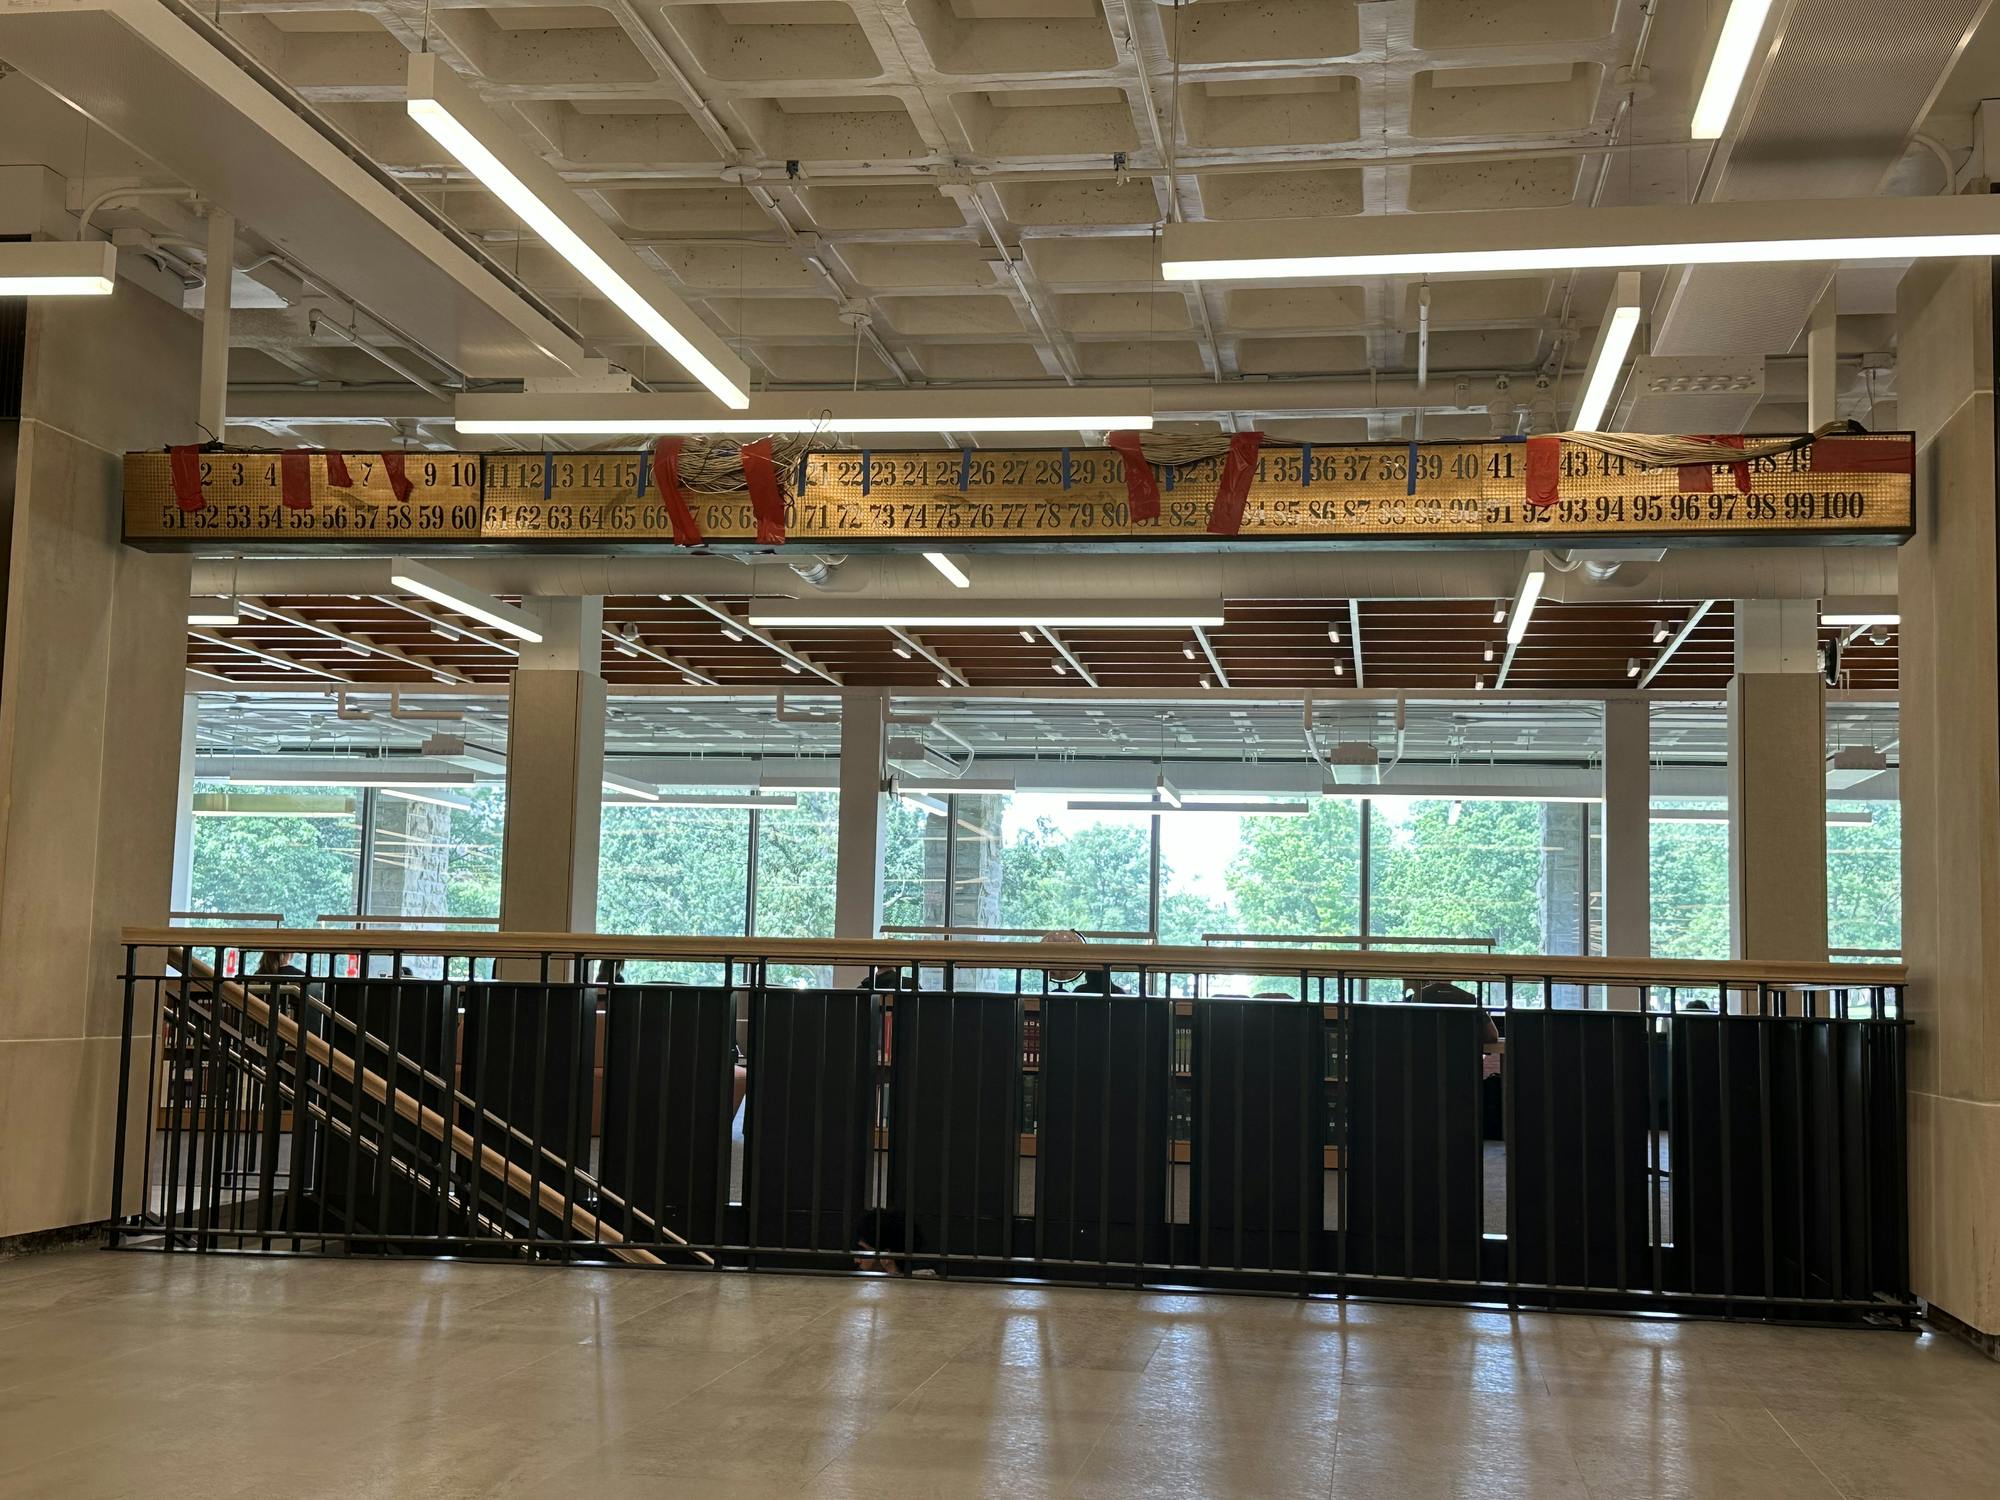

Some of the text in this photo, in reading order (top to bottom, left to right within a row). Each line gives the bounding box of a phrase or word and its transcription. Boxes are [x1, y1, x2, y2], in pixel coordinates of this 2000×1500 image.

[200, 462, 213, 487] 2
[232, 462, 244, 487] 3
[264, 463, 277, 487] 4
[360, 462, 373, 487] 7
[424, 462, 437, 487] 9
[451, 462, 476, 487] 10
[487, 463, 511, 488] 11
[517, 463, 543, 488] 12
[551, 463, 574, 488] 13
[582, 463, 605, 488] 14
[613, 463, 638, 488] 15
[806, 461, 828, 487] 21
[838, 461, 863, 487] 22
[871, 461, 896, 487] 23
[903, 461, 928, 486] 24
[936, 460, 961, 486] 25
[969, 460, 995, 485] 26
[1002, 460, 1029, 485] 27
[1035, 460, 1062, 485] 28
[1069, 459, 1096, 484] 29
[1103, 459, 1127, 484] 30
[1274, 456, 1301, 482] 35
[1310, 455, 1336, 482] 36
[1344, 455, 1372, 481] 37
[1379, 454, 1406, 481] 38
[1415, 454, 1443, 480] 39
[1450, 453, 1479, 480] 40
[1486, 452, 1515, 478] 41
[1560, 451, 1588, 477] 43
[1596, 452, 1624, 476] 44
[1785, 446, 1813, 473] 49
[162, 505, 187, 529] 51
[194, 505, 219, 529] 52
[226, 505, 251, 529] 53
[258, 504, 283, 529] 54
[290, 506, 315, 529] 55
[322, 505, 347, 529] 56
[354, 505, 379, 529] 57
[387, 505, 412, 529] 58
[418, 505, 444, 530] 59
[451, 505, 477, 530] 60
[485, 505, 509, 530] 61
[515, 505, 541, 530] 62
[547, 505, 573, 530] 63
[579, 505, 604, 530] 64
[611, 505, 636, 530] 65
[643, 505, 668, 529] 66
[706, 505, 733, 529] 68
[804, 505, 830, 529] 71
[837, 504, 862, 529] 72
[870, 503, 895, 529] 73
[902, 503, 928, 529] 74
[935, 503, 961, 529] 75
[968, 503, 994, 528] 76
[1001, 503, 1028, 528] 77
[1035, 503, 1061, 528] 78
[1068, 503, 1095, 528] 79
[1101, 502, 1128, 528] 80
[1169, 501, 1198, 527] 82
[1273, 500, 1301, 526] 85
[1309, 499, 1336, 526] 86
[1343, 499, 1371, 526] 87
[1378, 499, 1406, 525] 88
[1413, 498, 1442, 525] 89
[1450, 498, 1479, 525] 90
[1486, 497, 1514, 523] 91
[1558, 498, 1588, 523] 93
[1595, 496, 1625, 522] 94
[1633, 495, 1663, 521] 95
[1670, 494, 1700, 521] 96
[1708, 494, 1738, 520] 97
[1746, 493, 1776, 520] 98
[1784, 492, 1815, 519] 99
[1820, 491, 1864, 519] 100
